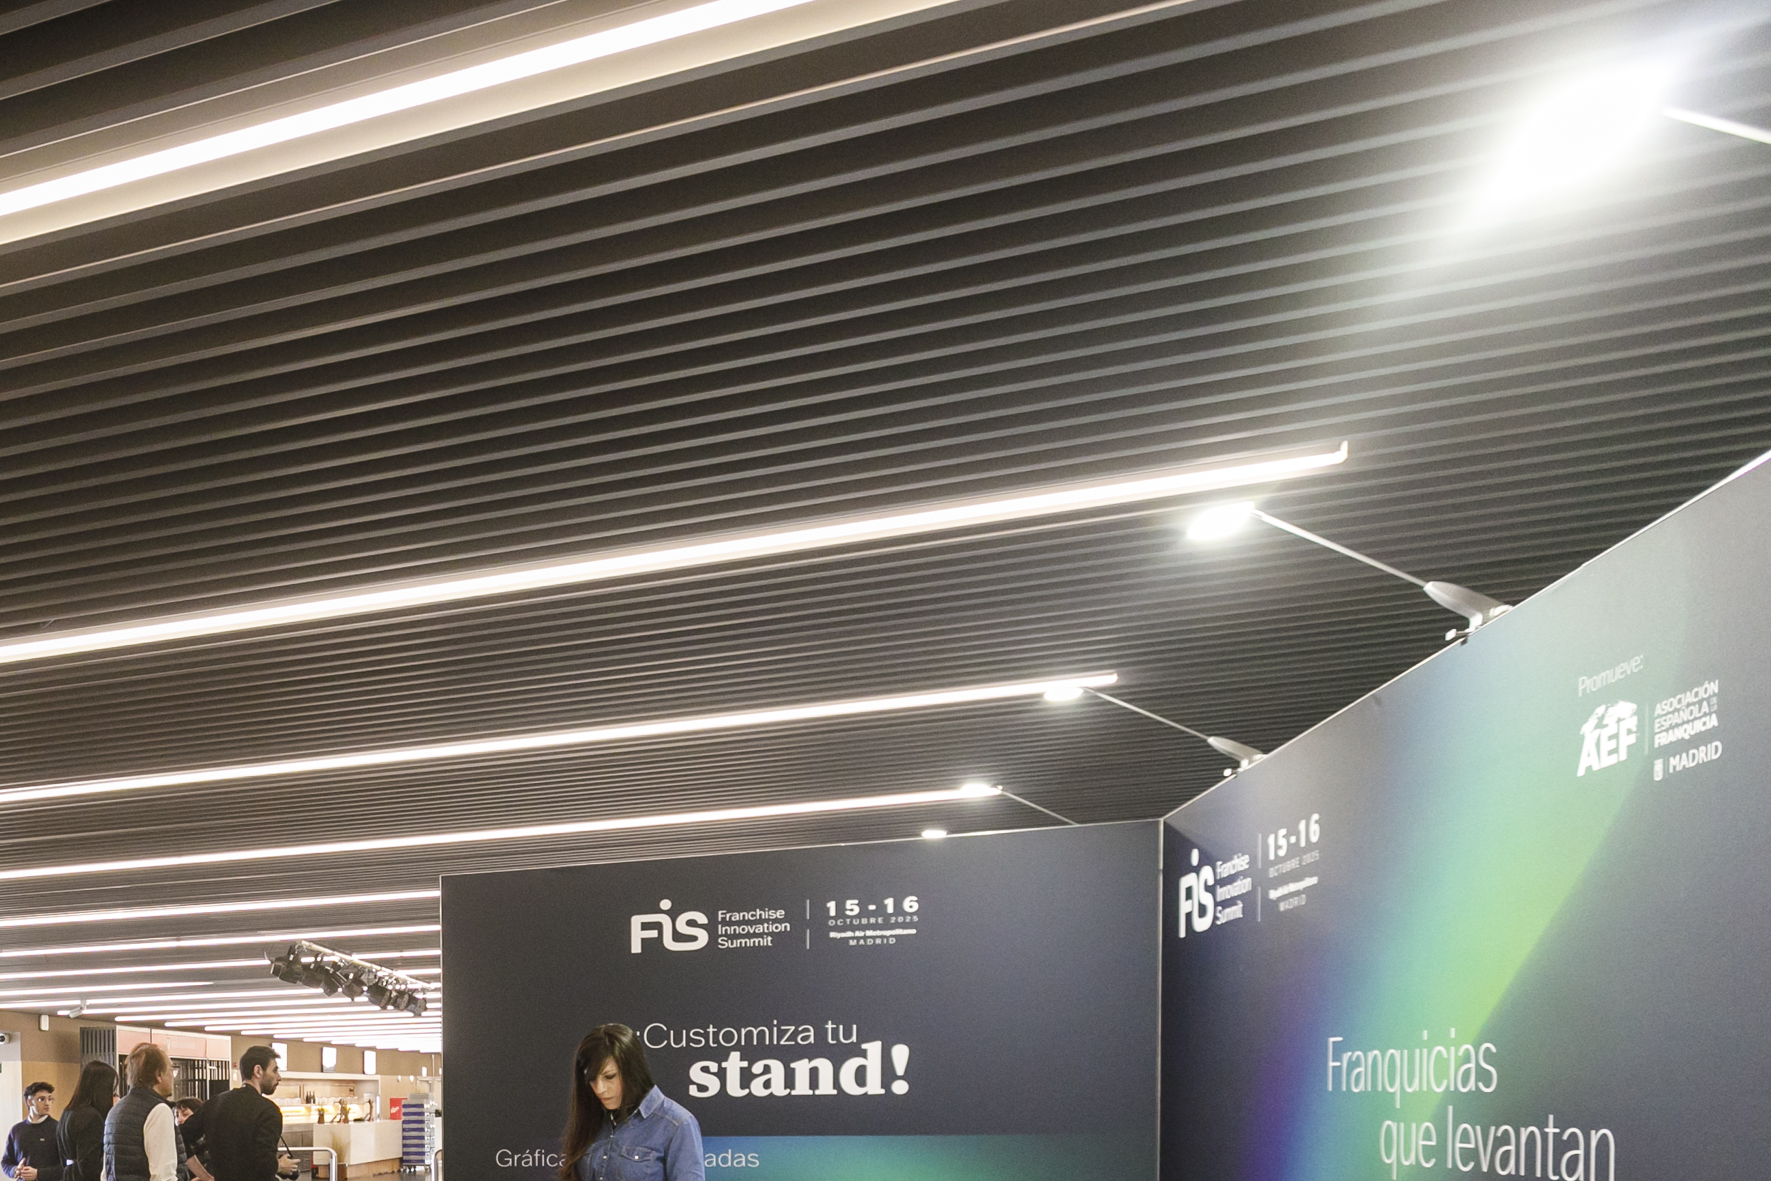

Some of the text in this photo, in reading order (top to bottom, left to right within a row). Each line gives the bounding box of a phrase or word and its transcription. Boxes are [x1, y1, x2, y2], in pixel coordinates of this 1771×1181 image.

[1578, 653, 1644, 697] Promueve:
[1654, 679, 1719, 717] ASOCIACIÓN
[1654, 700, 1710, 733] ESPAÑOLA
[1654, 713, 1719, 749] FRANQUICIA
[1577, 715, 1638, 777] AEF
[1669, 741, 1722, 773] MADRID
[1267, 813, 1320, 860] 15-16
[717, 907, 786, 922] Franchise
[717, 921, 791, 935] Innovation
[828, 915, 919, 926] OCTUBRE 2025
[717, 935, 773, 949] Summit
[829, 930, 855, 939] Riyadh
[865, 928, 917, 937] Metropolitano
[849, 937, 896, 946] MADRID
[636, 1019, 858, 1049] Customiza tu
[688, 1040, 910, 1098] stand!
[1327, 1027, 1498, 1109] Franquicias
[495, 1148, 568, 1168] Gráfica
[1380, 1119, 1437, 1180] que
